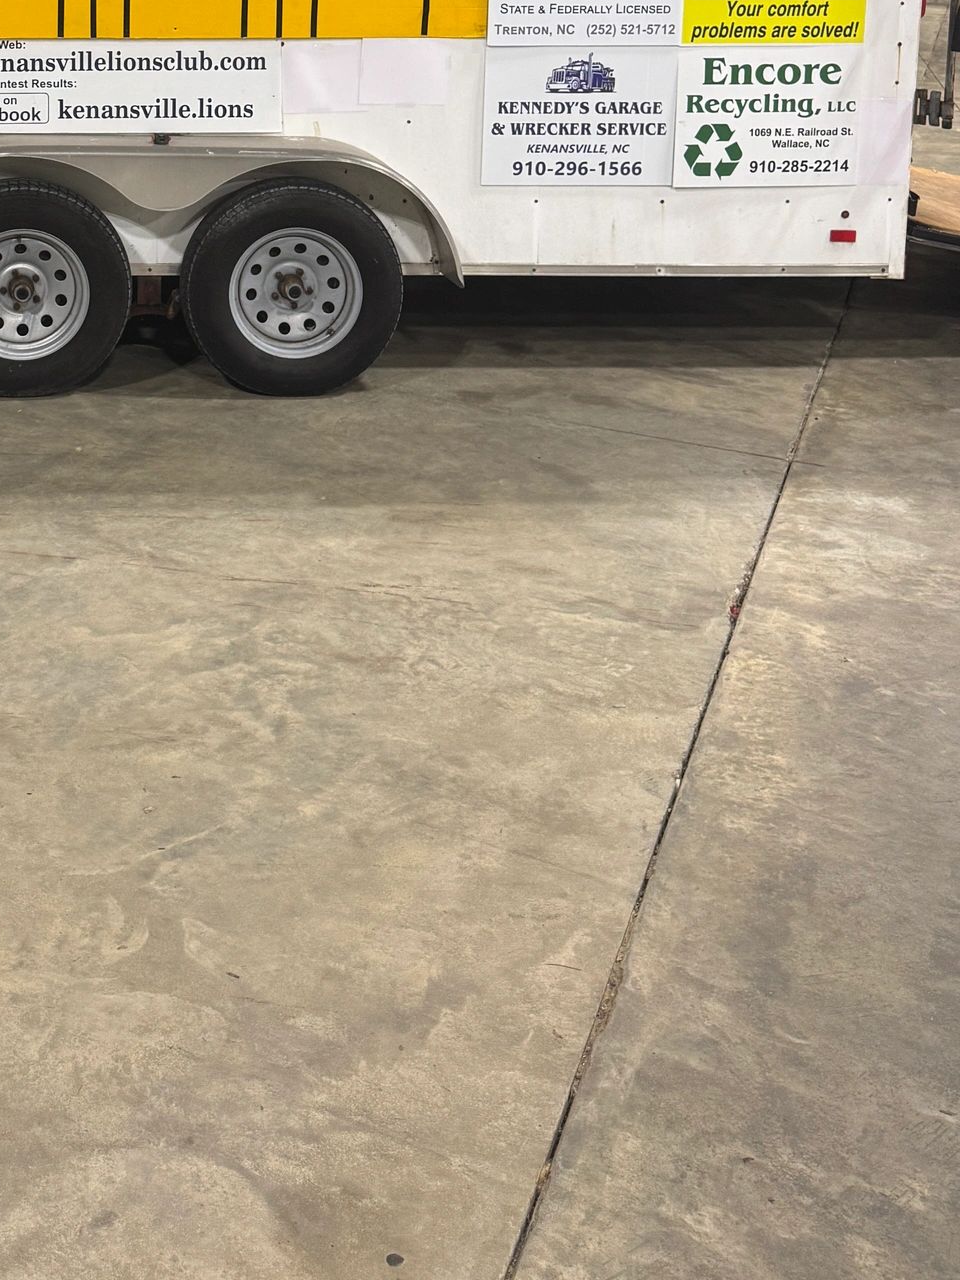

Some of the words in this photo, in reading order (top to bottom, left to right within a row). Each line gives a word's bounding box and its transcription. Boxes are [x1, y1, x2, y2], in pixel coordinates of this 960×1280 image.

[495, 24, 552, 36] TRENTON,
[557, 24, 575, 35] NC
[586, 24, 617, 37] (252)
[620, 24, 675, 35] 521-5712
[702, 58, 842, 85] Encore
[32, 79, 77, 88] Results:
[3, 97, 17, 105] on
[686, 94, 821, 118] Recycling,
[828, 101, 856, 112] LLC
[58, 98, 254, 121] kenansville.lions
[749, 128, 771, 136] 1069
[775, 128, 794, 136] N.E.
[797, 128, 838, 136] Railroad
[772, 140, 812, 149] Wallace,
[749, 160, 849, 173] 910-285-2214
